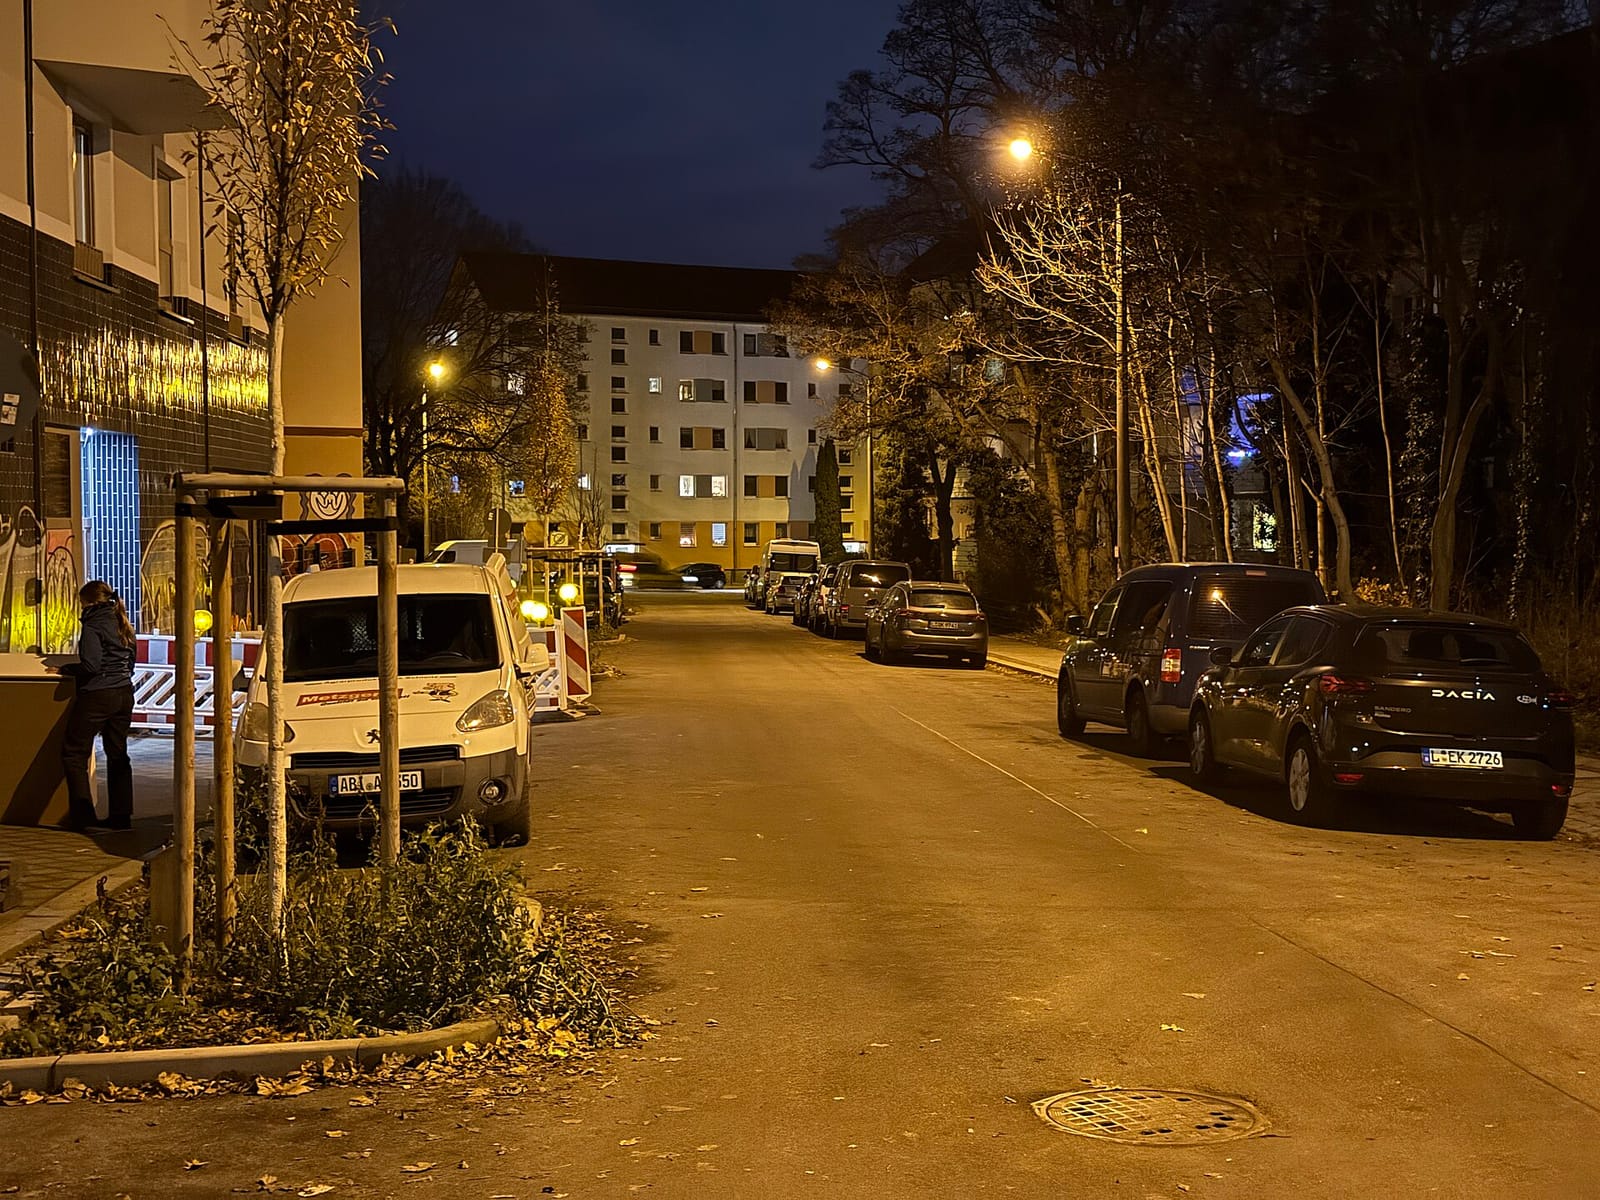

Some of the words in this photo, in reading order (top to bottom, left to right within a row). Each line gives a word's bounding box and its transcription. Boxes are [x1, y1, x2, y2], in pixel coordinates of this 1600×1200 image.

[1431, 688, 1496, 701] DACIA
[1430, 750, 1440, 762] L
[1448, 751, 1465, 764] EK
[1468, 752, 1501, 765] 2726
